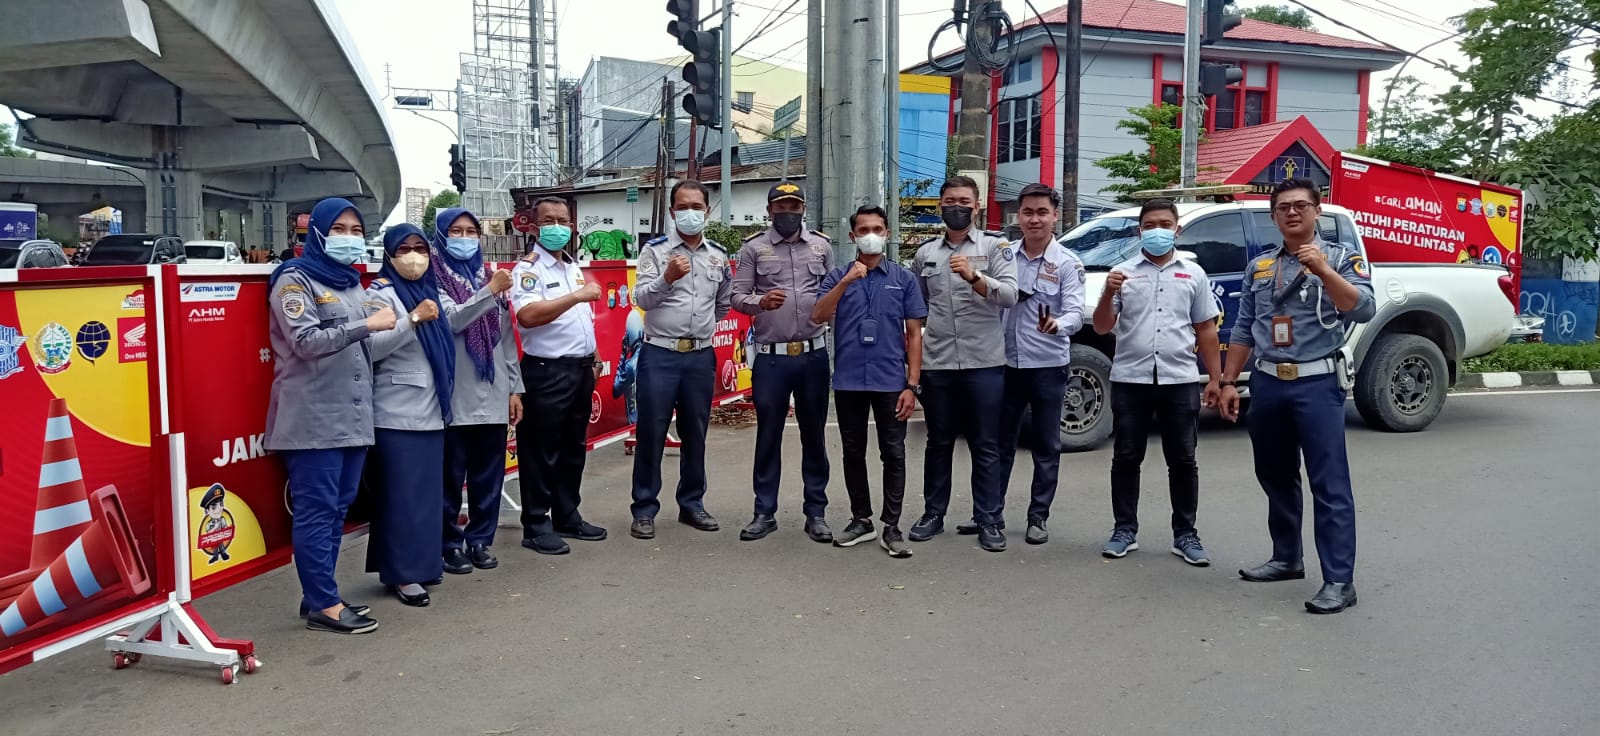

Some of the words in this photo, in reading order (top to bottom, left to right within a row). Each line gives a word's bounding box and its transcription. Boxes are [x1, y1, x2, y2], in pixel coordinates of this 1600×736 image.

[1393, 217, 1466, 242] PERATURAN
[1357, 225, 1412, 246] BERLALU
[1414, 235, 1456, 254] LINTAS
[194, 285, 213, 293] ASTRA
[188, 307, 225, 318] AHM
